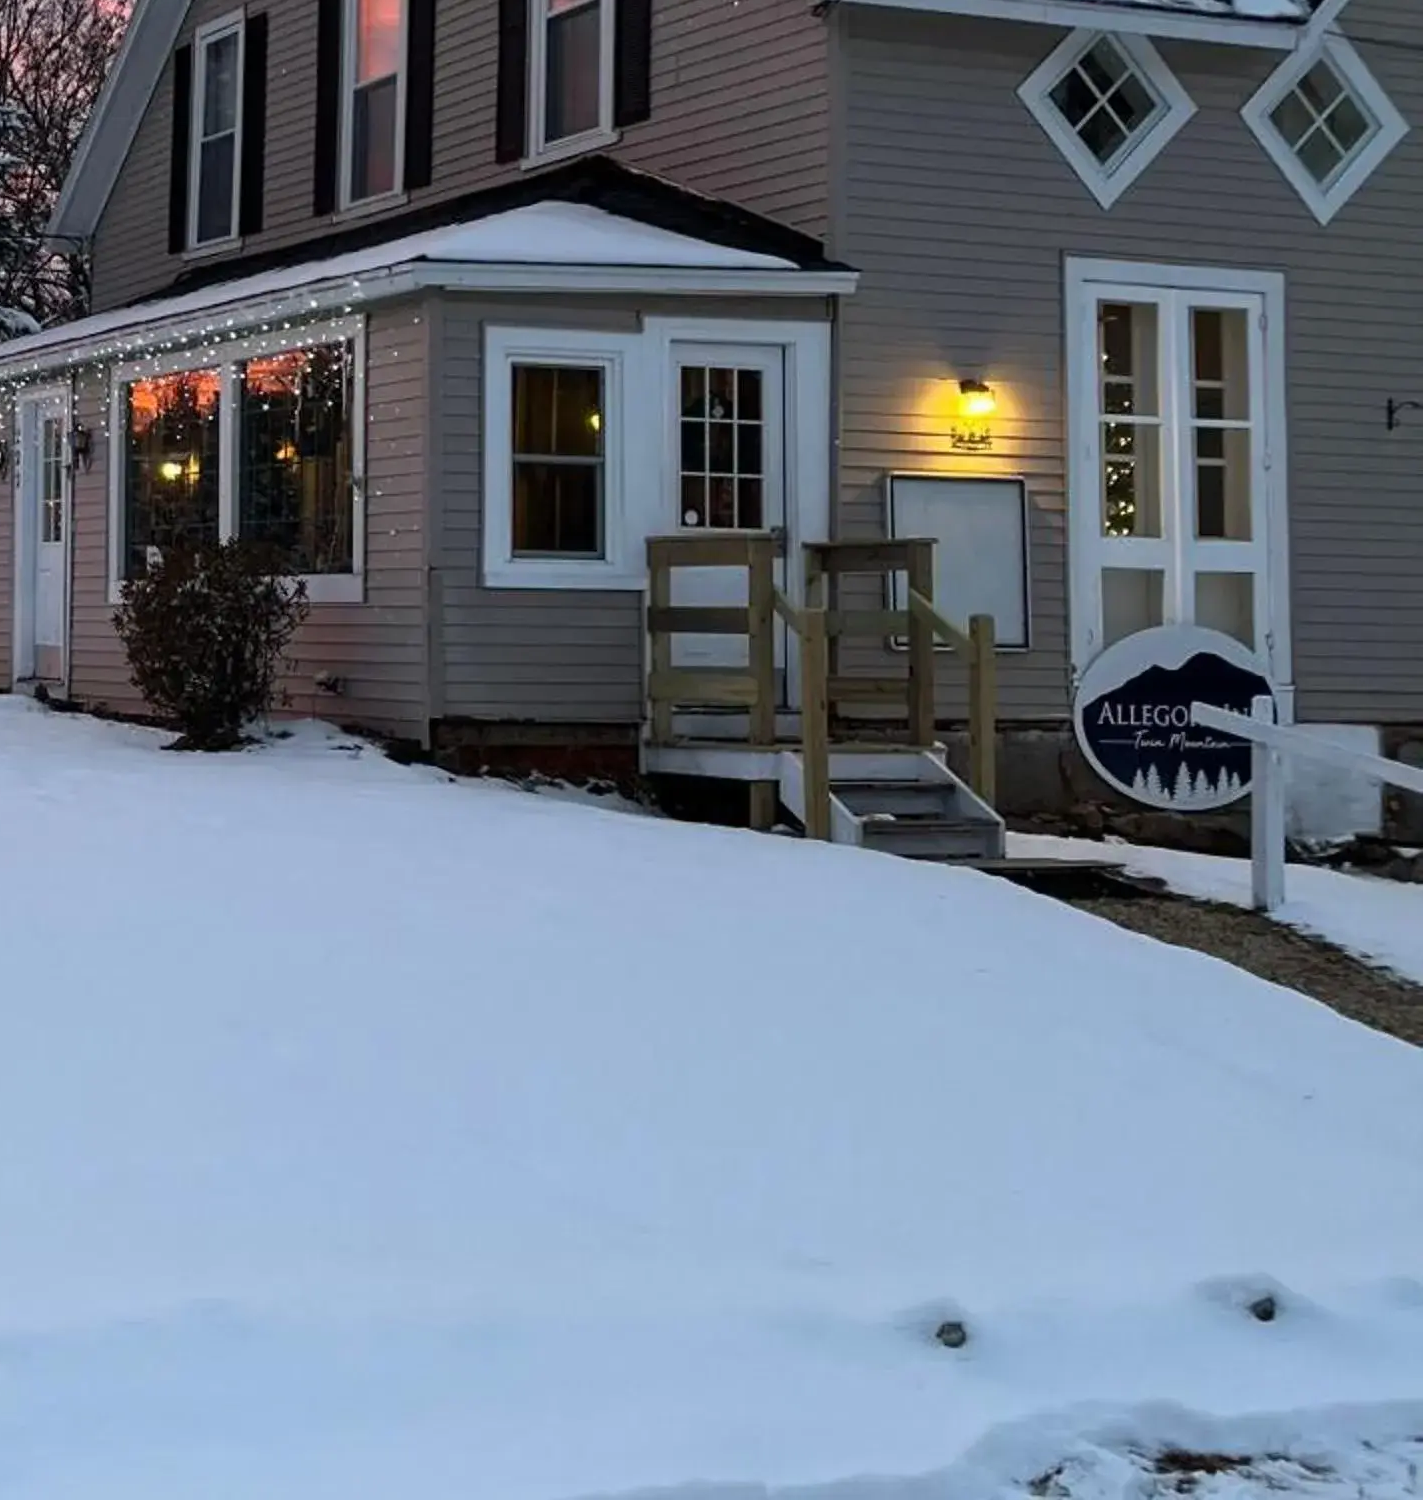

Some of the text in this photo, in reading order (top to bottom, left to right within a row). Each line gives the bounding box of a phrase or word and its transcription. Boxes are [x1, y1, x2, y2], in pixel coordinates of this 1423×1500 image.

[1097, 701, 1195, 727] ALLEGO
[1134, 729, 1232, 752] Twin Mountain
